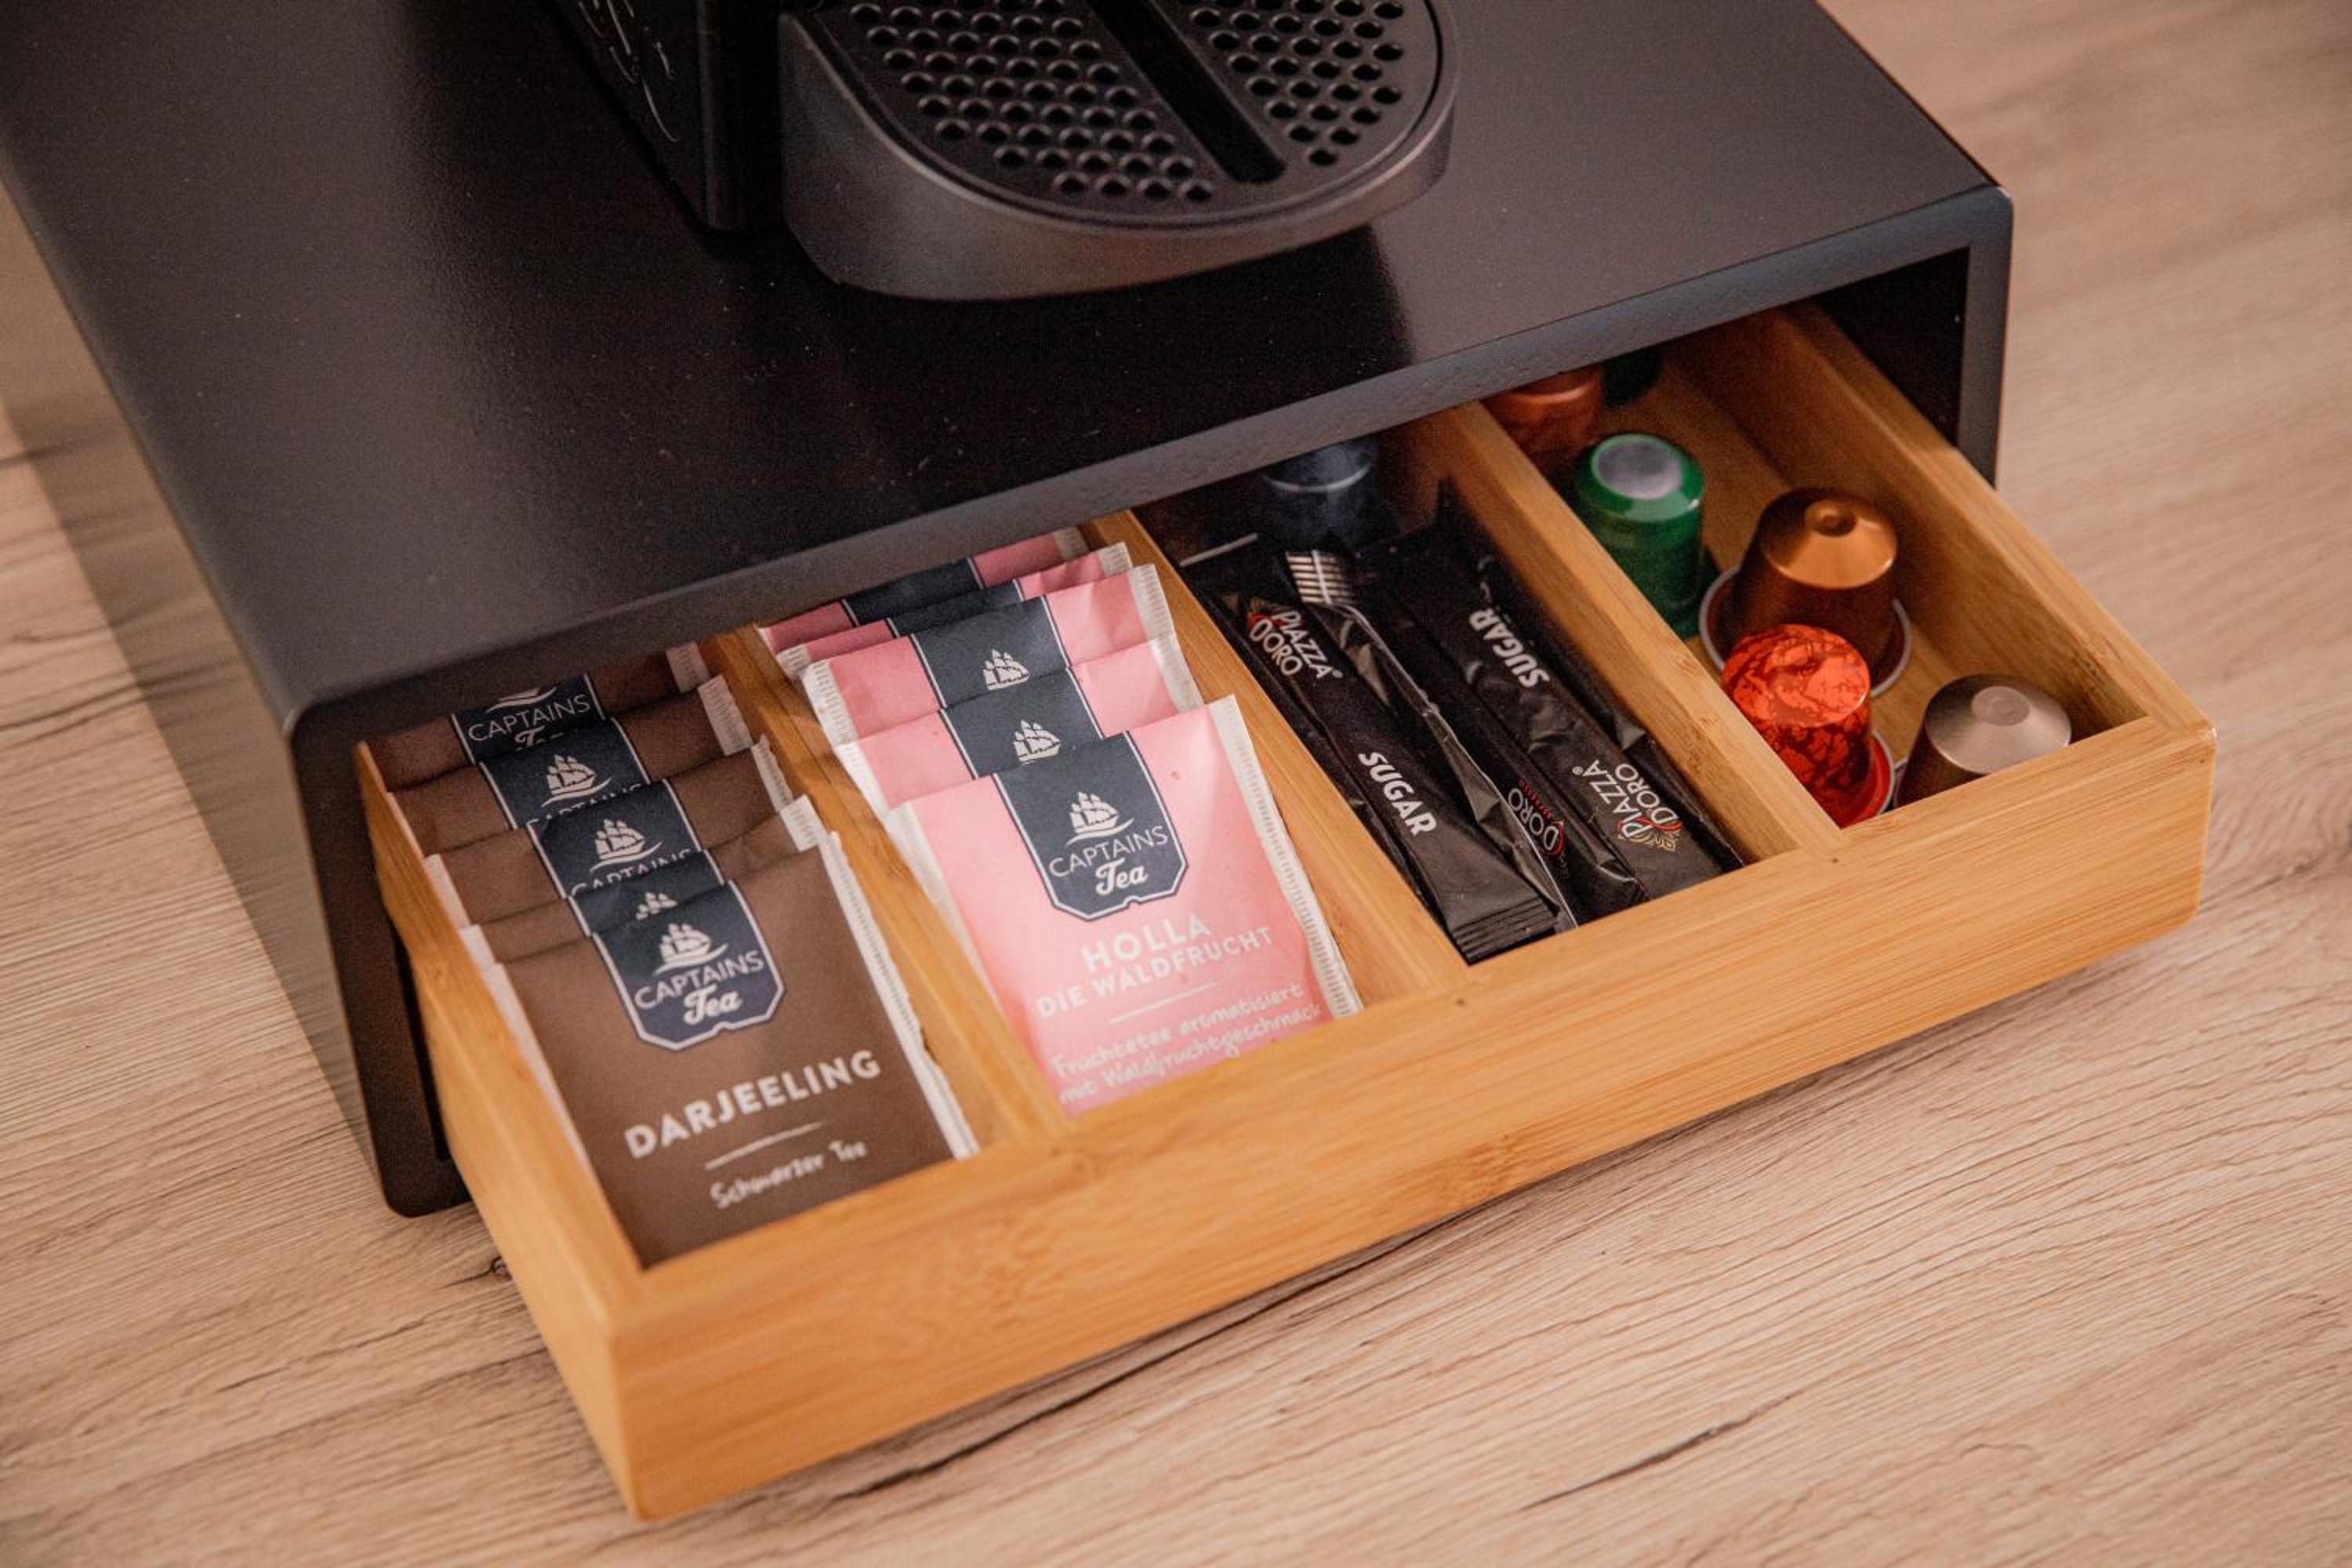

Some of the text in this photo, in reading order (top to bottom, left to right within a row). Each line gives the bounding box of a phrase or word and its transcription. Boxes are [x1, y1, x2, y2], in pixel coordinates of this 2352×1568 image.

[1469, 607, 1550, 688] SUGAR
[468, 694, 590, 741] CAPTAINS
[1358, 751, 1438, 837] SUGAR
[1048, 826, 1168, 877] CAPTAINS
[1094, 857, 1149, 896] Tea
[1080, 913, 1211, 974] HOLLA
[634, 949, 764, 1010] CAPTAINS
[1036, 927, 1274, 1018] DIE WALDFRUCHT
[683, 982, 742, 1025] Tea
[1178, 982, 1305, 1036] aromatisiert
[624, 1050, 881, 1159] DARJEELING
[828, 1139, 867, 1163] Tee
